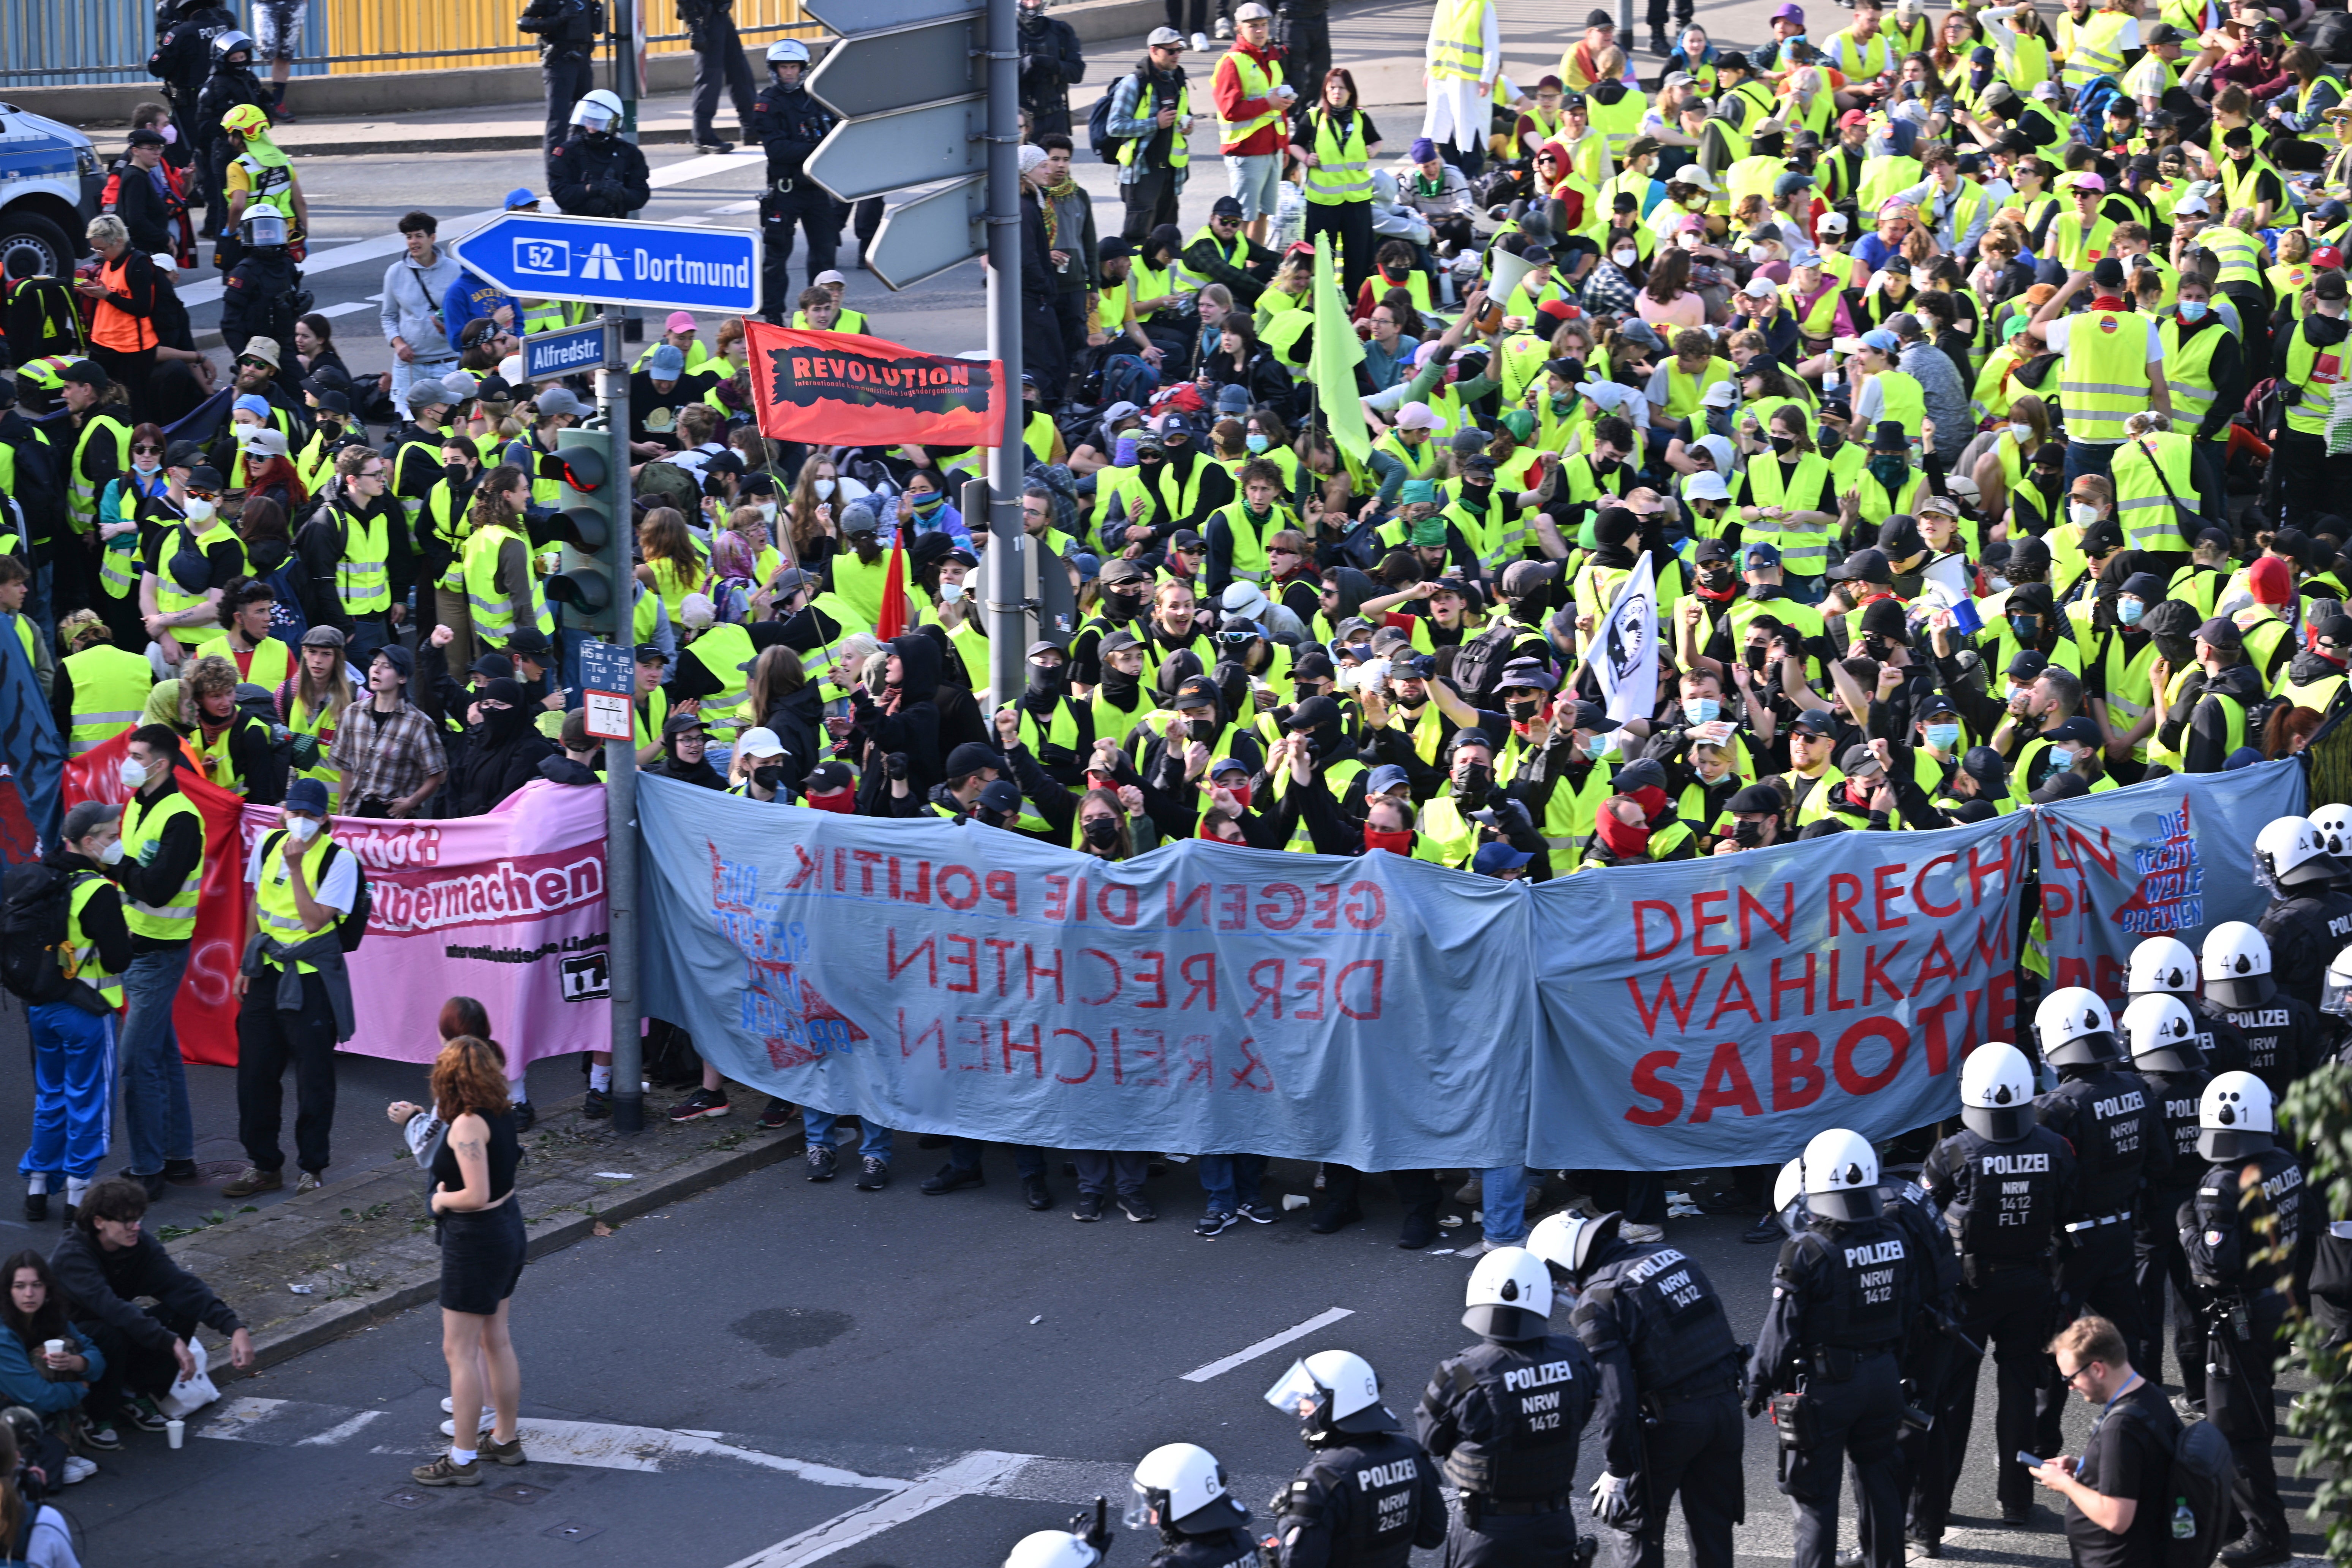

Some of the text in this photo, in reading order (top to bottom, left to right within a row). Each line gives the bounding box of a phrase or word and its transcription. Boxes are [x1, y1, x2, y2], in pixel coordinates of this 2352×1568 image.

[528, 246, 749, 289] 52 Dortmund
[533, 341, 601, 370] Alfredstr.
[792, 357, 969, 388] REVOLUTION
[847, 382, 898, 397] kommunistische
[900, 387, 969, 397] Jugendorganisation
[2299, 837, 2309, 851] 4
[2135, 838, 2199, 874] RECHTE
[2145, 868, 2205, 904] WELLE
[1632, 882, 1793, 962] DEN
[2121, 899, 2203, 933] BRECHEN
[2220, 953, 2260, 971] 4 1
[2154, 968, 2165, 984] 4
[2063, 1017, 2074, 1032] 4
[2227, 1009, 2292, 1028] POLIZEI
[2159, 1022, 2170, 1037] 4
[1982, 1084, 2020, 1103] 4 1
[2093, 1091, 2145, 1120] POLIZEI
[2240, 1106, 2248, 1123] 1
[2110, 1118, 2140, 1139] NRW
[2115, 1135, 2139, 1154] 1412
[1829, 1164, 1872, 1184] 4 1
[1982, 1153, 2049, 1175] POLIZEI
[2002, 1181, 2030, 1194] NRW
[2262, 1165, 2303, 1201] POLIZEI
[2000, 1196, 2031, 1210] 1412
[1999, 1211, 2029, 1226] FLT
[1844, 1240, 1905, 1268] POLIZEI
[1627, 1249, 1686, 1284] POLIZEI
[1657, 1269, 1691, 1296] NRW
[1860, 1268, 1894, 1288] NRW
[1524, 1284, 1532, 1301] 1
[1672, 1285, 1701, 1308] 1412
[1864, 1287, 1891, 1304] 1412
[1504, 1360, 1573, 1392] POLIZEI
[1365, 1378, 1375, 1396] 6
[1521, 1391, 1560, 1414] NRW
[1528, 1413, 1560, 1432] 1412
[1205, 1475, 1215, 1495] 6
[1357, 1458, 1418, 1492] POLIZEI
[1378, 1489, 1411, 1514] NRW
[1378, 1509, 1408, 1532] 2621
